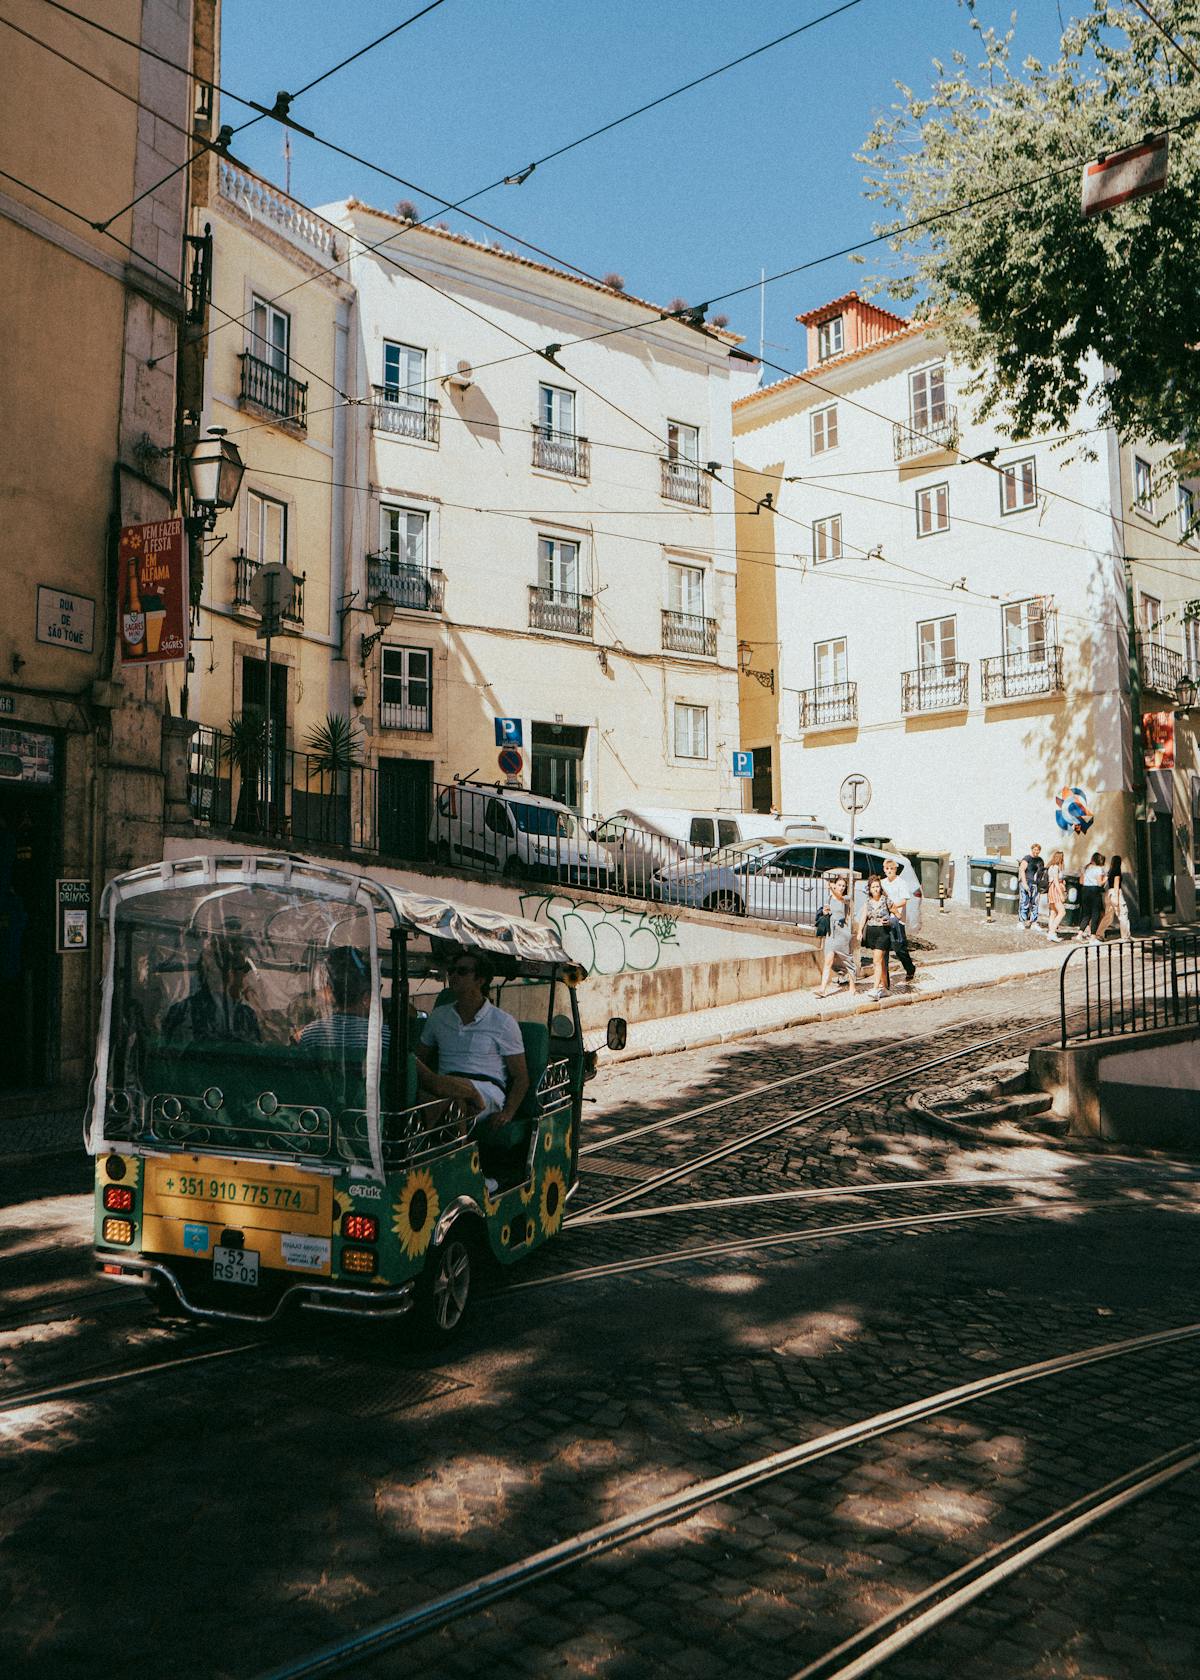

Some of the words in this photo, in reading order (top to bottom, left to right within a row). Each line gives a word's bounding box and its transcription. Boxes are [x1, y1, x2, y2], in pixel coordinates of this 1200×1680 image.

[142, 524, 158, 540] VEM
[159, 520, 181, 538] FAZER
[143, 539, 149, 554] A
[150, 536, 172, 552] FESTA
[145, 552, 157, 568] EM
[141, 564, 170, 582] ALFAMA
[59, 598, 74, 612] RUA
[61, 614, 71, 626] DE
[47, 623, 62, 639] SÃO
[64, 629, 84, 644] TOMÉ
[160, 639, 184, 651] SAGRES
[501, 719, 516, 740] P
[737, 753, 748, 771] P
[61, 882, 87, 892] COLD
[59, 891, 91, 903] DRINKS
[178, 1176, 205, 1197] 351
[209, 1180, 237, 1201] 910
[241, 1184, 270, 1205] 775
[273, 1188, 303, 1209] 774
